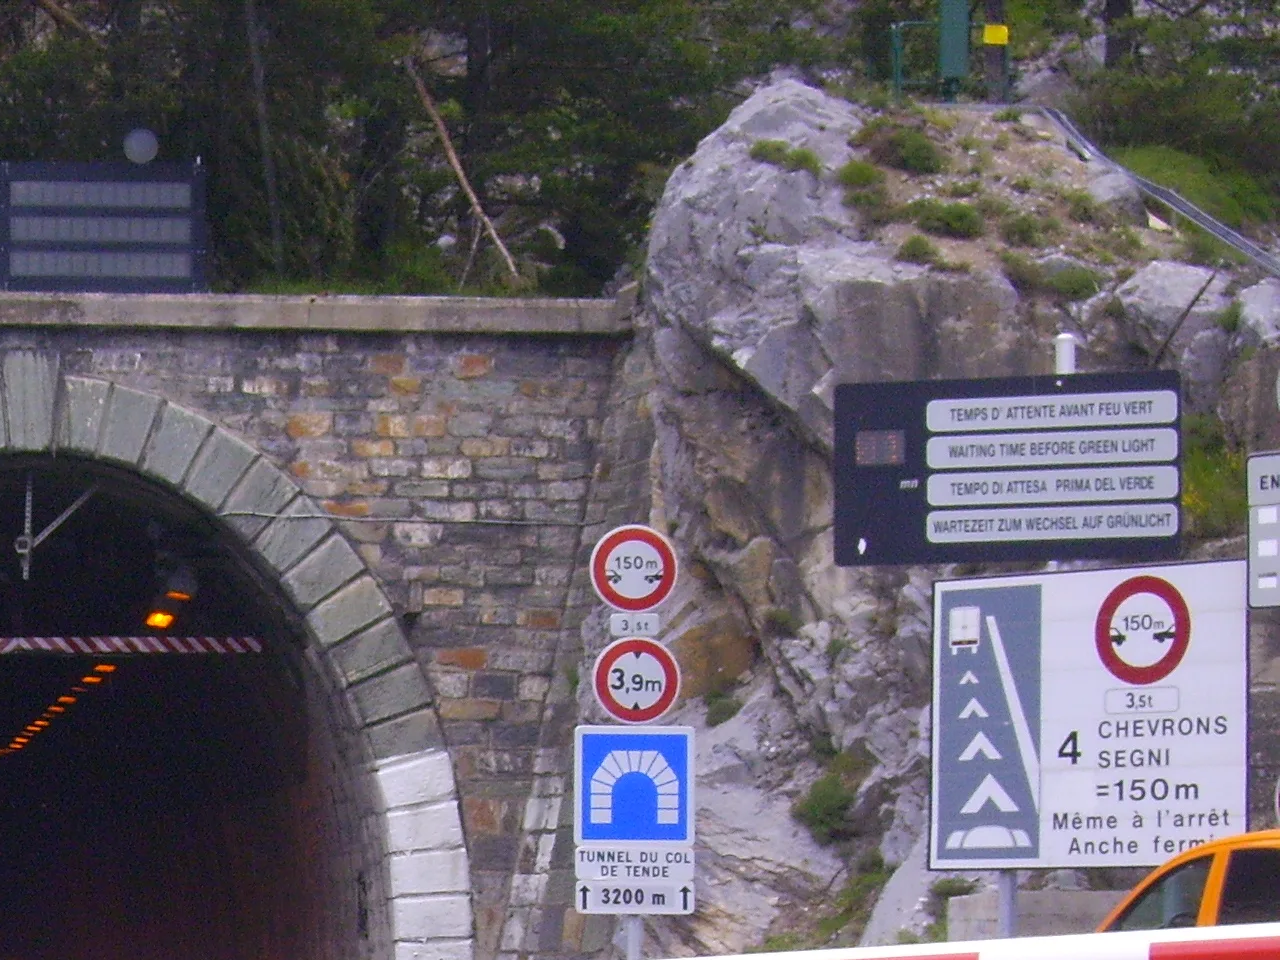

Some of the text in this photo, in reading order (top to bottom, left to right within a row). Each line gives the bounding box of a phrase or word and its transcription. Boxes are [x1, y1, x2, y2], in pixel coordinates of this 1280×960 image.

[950, 407, 988, 422] TEMPS
[1006, 404, 1056, 420] ATTENTE
[1059, 402, 1095, 418] AVANT
[1098, 401, 1121, 416] FEU
[1123, 400, 1153, 415] VERT
[948, 438, 1155, 458] WAITING TIME BEFORE GREEN LIGHT
[950, 476, 1154, 496] TEMPO DI ATTESA PRIMA DEL VERDE
[933, 511, 1172, 534] WARTEZEIT ZUM WECHSEL AUF GRÜNLICHT
[1122, 614, 1165, 631] 150m
[611, 667, 662, 694] 3,9m
[1125, 692, 1153, 710] 3,5t
[1098, 715, 1228, 739] CHEVRONS
[1057, 730, 1082, 765] 4
[1098, 748, 1171, 769] SEGNI
[1052, 808, 1230, 831] Même à l'arrêt
[1068, 837, 1139, 855] Anche
[579, 850, 691, 864] TUNNEL DU COL
[600, 865, 669, 878] DE TENDE
[601, 888, 666, 906] 3200 m
